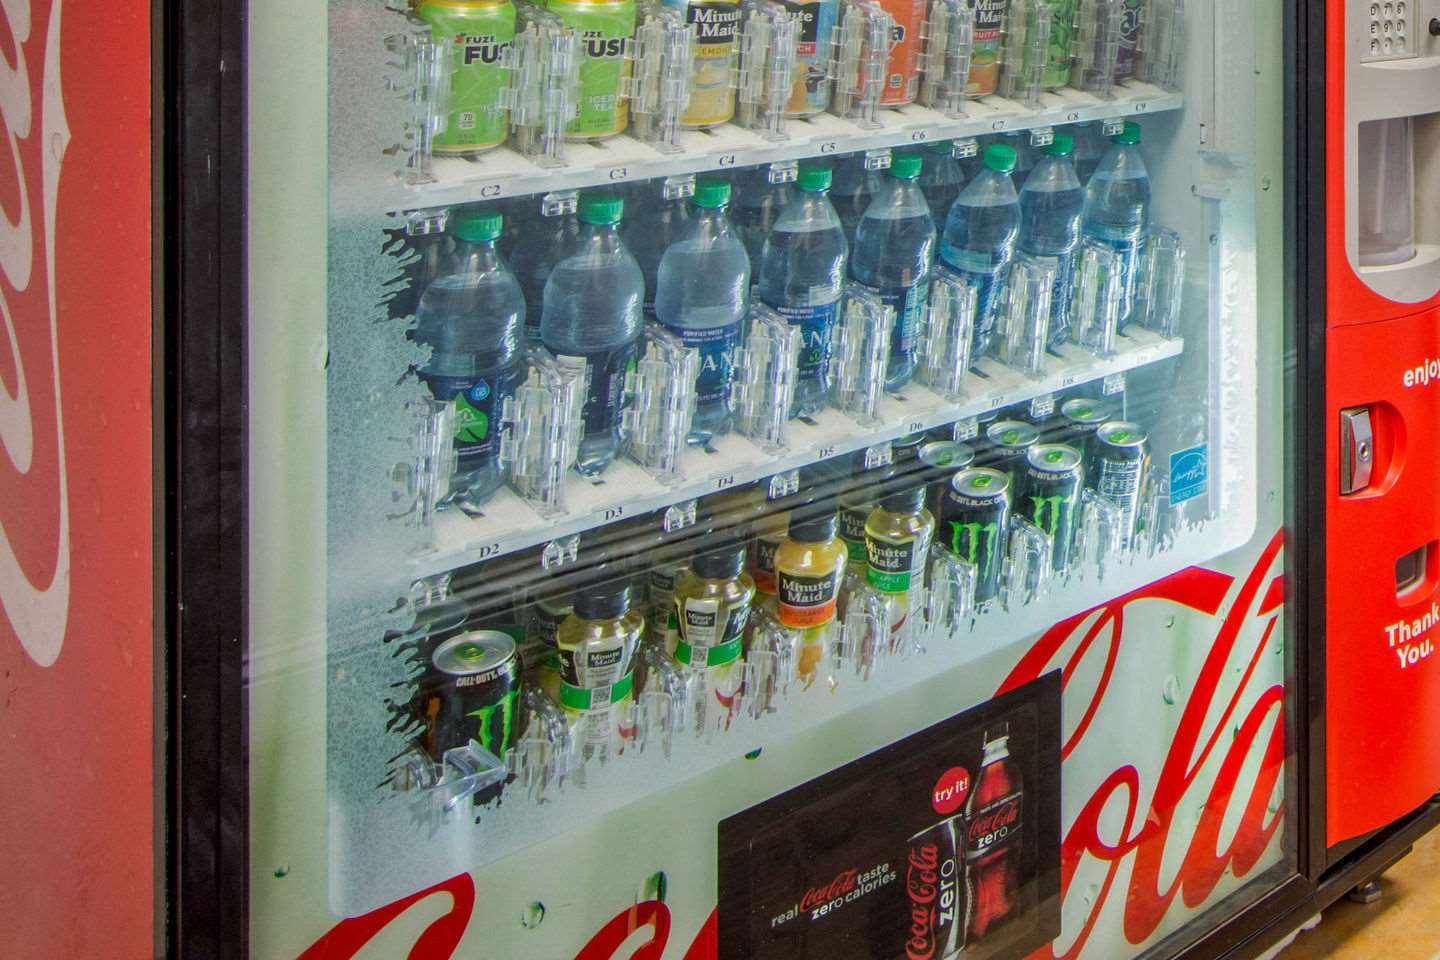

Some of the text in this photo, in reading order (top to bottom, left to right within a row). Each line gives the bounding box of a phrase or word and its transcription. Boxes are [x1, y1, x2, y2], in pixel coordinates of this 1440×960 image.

[466, 36, 495, 44] FUZE
[991, 120, 1005, 130] C7
[911, 130, 926, 141] C6
[820, 142, 836, 153] C5
[719, 155, 735, 166] C4
[609, 167, 627, 180] C3
[481, 185, 501, 197] C2
[910, 422, 923, 433] D6
[819, 446, 834, 459] D5
[718, 475, 735, 489] D4
[605, 506, 623, 521] D3
[480, 542, 500, 558] D2
[782, 578, 832, 593] Minute
[787, 590, 823, 603] Maid
[1385, 603, 1440, 648] Thank
[1397, 642, 1434, 670] You.
[935, 777, 968, 803] try it!
[978, 826, 1008, 849] zero
[770, 903, 799, 928] real
[857, 862, 890, 886] taste
[811, 869, 896, 921] zero calories
[939, 859, 955, 927] zero
[906, 843, 938, 960] Coca-Cola
